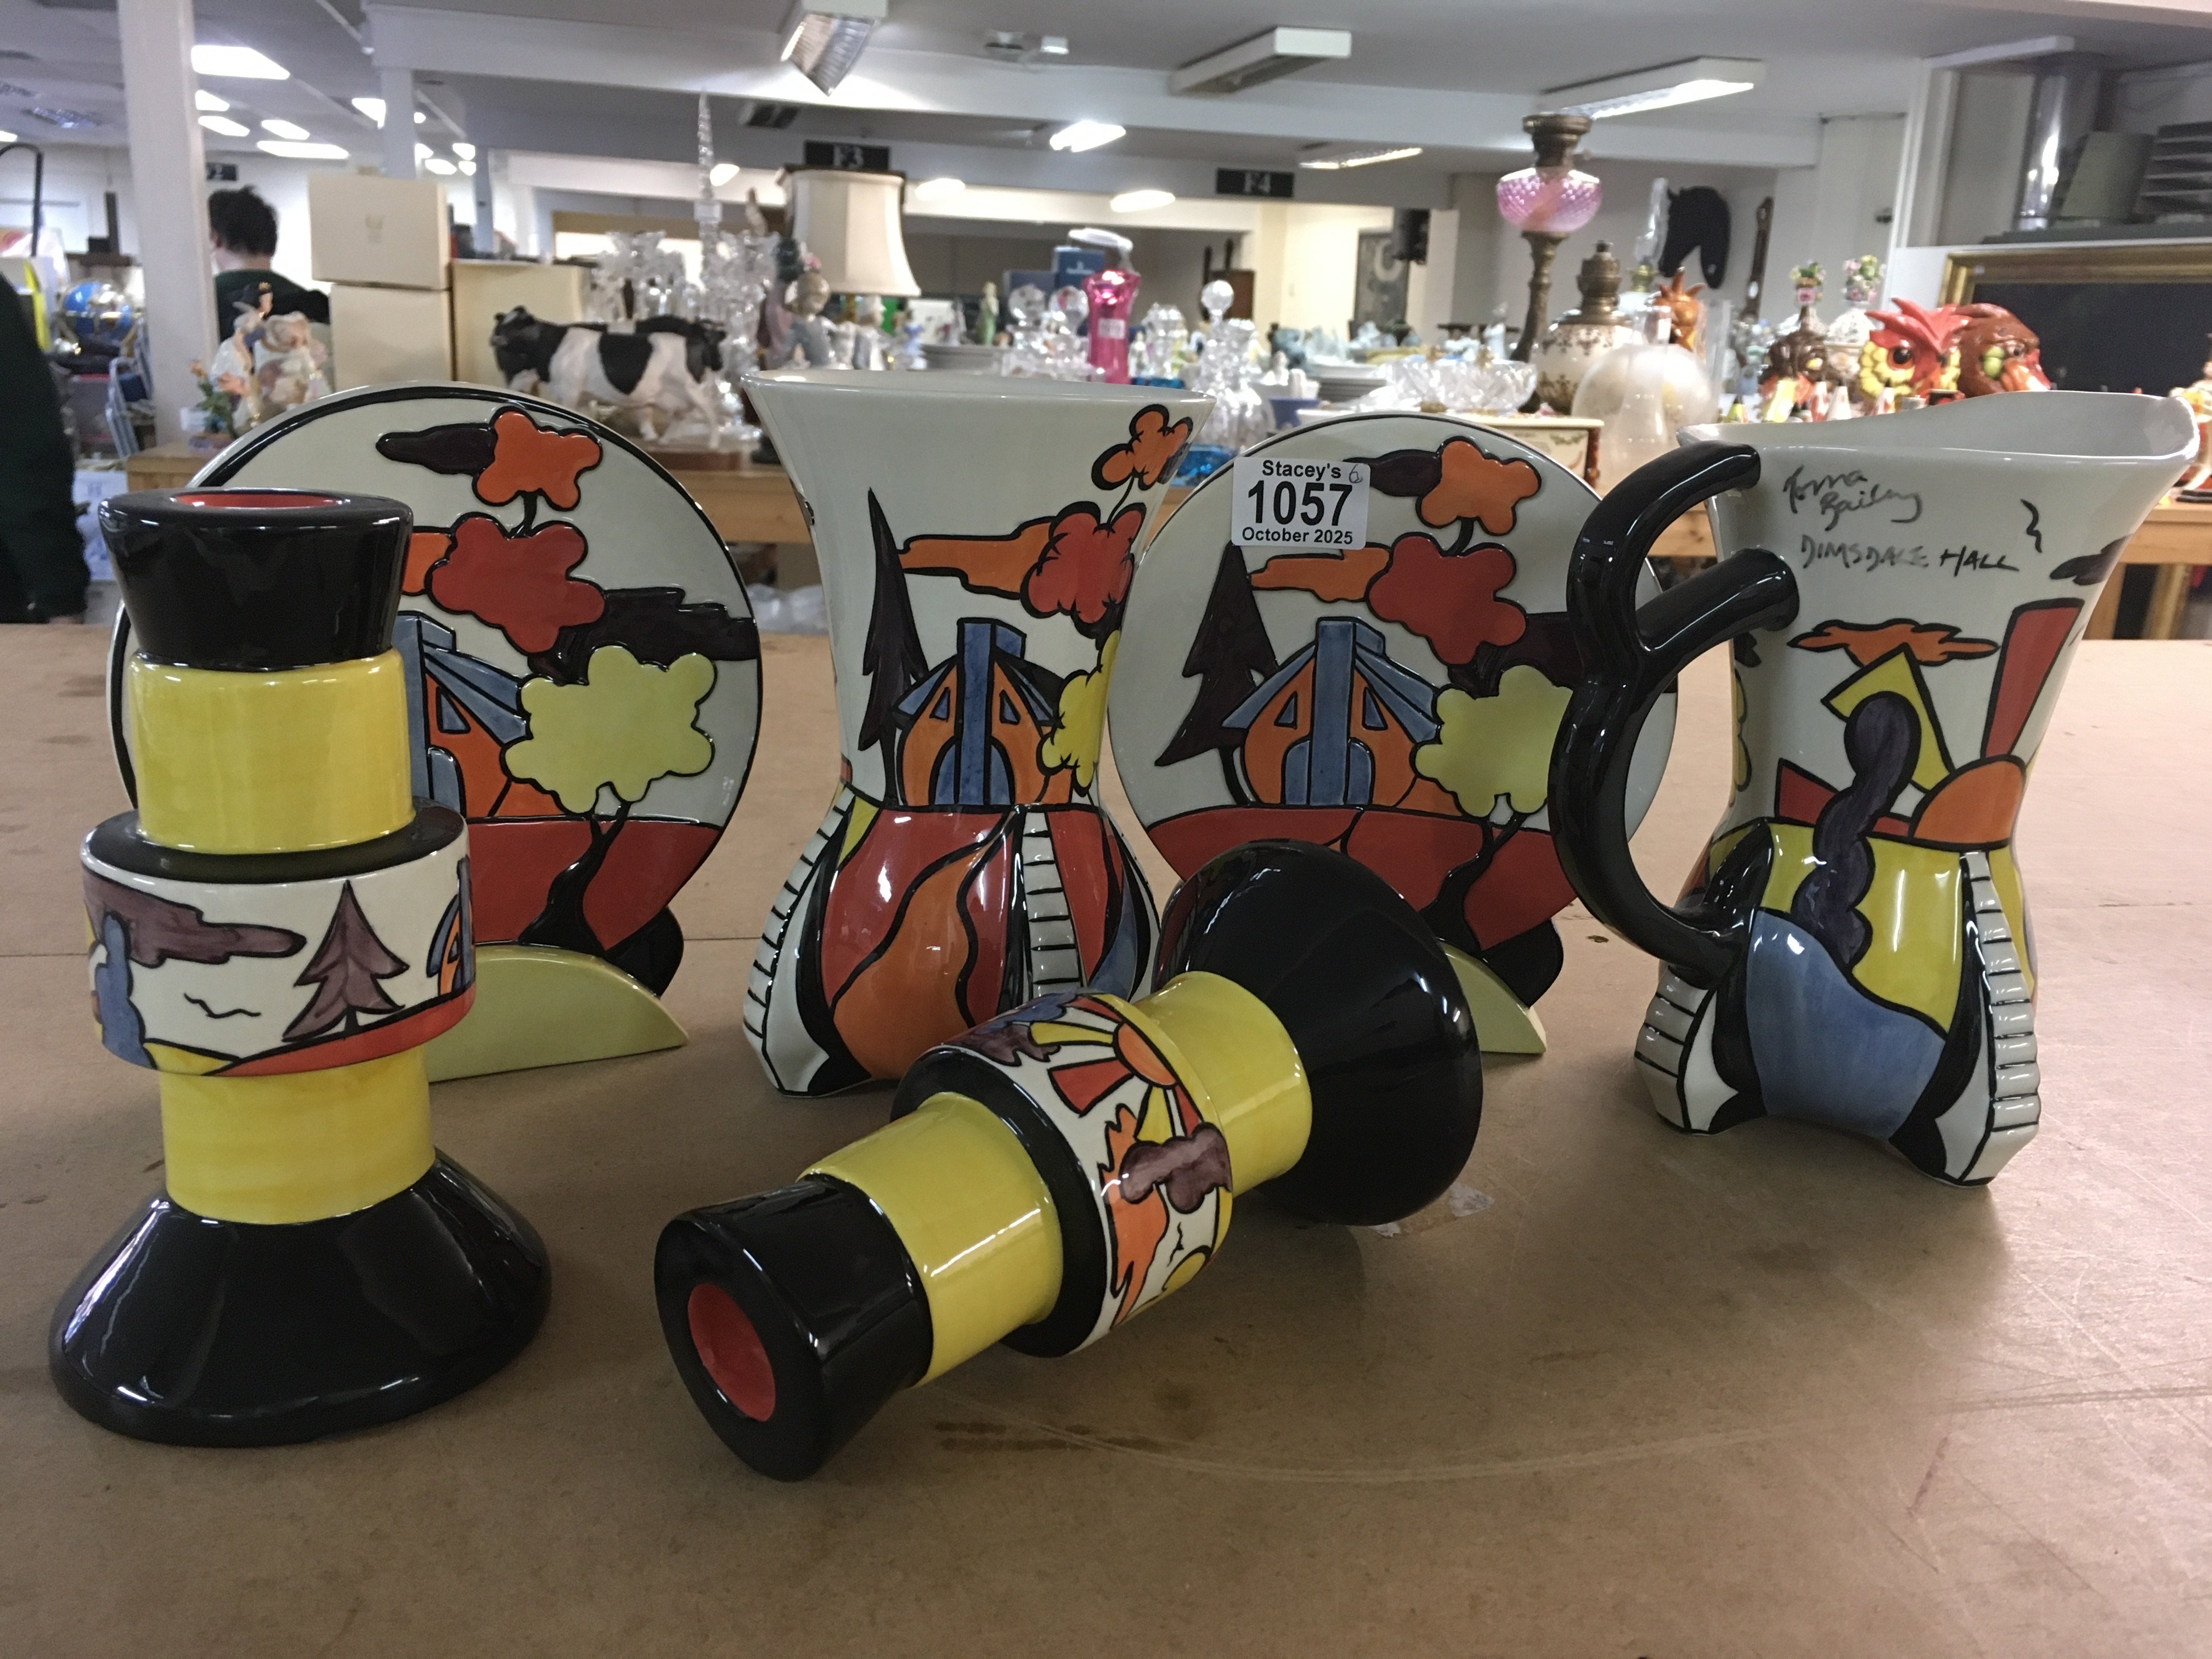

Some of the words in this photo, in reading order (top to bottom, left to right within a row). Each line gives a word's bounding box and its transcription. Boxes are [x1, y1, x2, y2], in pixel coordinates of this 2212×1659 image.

[1262, 460, 1341, 481] Stacey's
[1248, 480, 1353, 526] 1057
[1242, 527, 1310, 543] October
[1313, 529, 1353, 544] 2025
[1939, 545, 2019, 577] HALL
